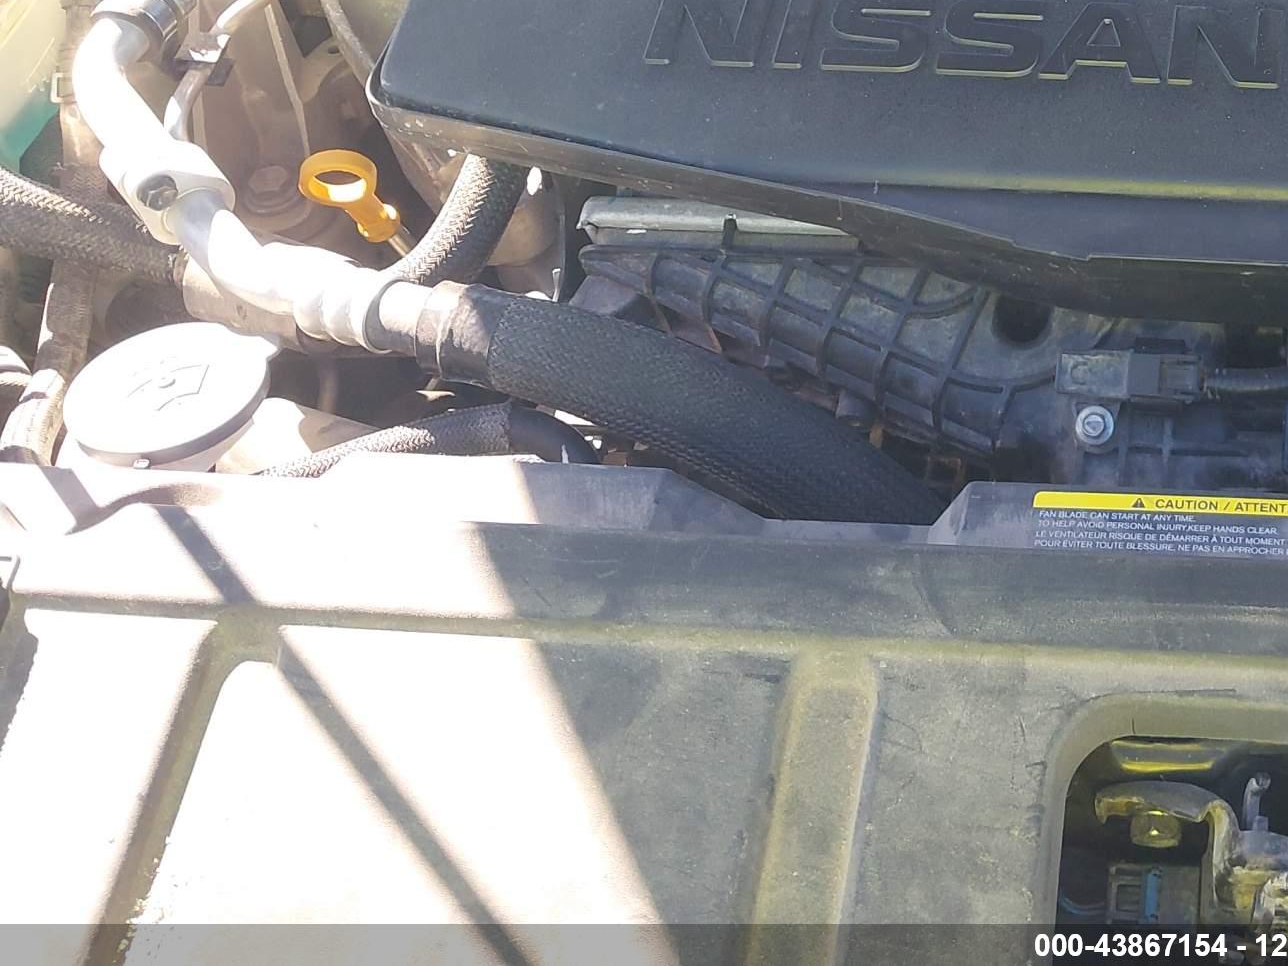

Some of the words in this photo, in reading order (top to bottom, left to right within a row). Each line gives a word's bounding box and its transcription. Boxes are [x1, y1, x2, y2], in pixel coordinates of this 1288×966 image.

[1155, 498, 1219, 511] CAUTION
[1223, 501, 1230, 511] /
[1039, 510, 1056, 518] FAN
[1058, 511, 1087, 519] BLADE
[1090, 512, 1109, 520] CAN
[1110, 513, 1139, 521] START
[1153, 514, 1172, 522] ANY
[1077, 521, 1105, 529] AVOID
[1106, 522, 1154, 531] PERSONAL
[1213, 525, 1245, 534] HANDS
[1035, 530, 1047, 538] LE
[1048, 531, 1107, 540] VENTILATEUR
[1109, 532, 1143, 541] RISQUE
[1145, 533, 1157, 541] DE
[1159, 532, 1210, 543] DÉMARRER
[1219, 536, 1244, 544] TOUT
[1096, 541, 1124, 549] TOUTE
[1178, 544, 1191, 552] NE
[1192, 544, 1210, 552] PAS
[1212, 545, 1225, 553] EN
[1227, 546, 1284, 555] APPROCHER
